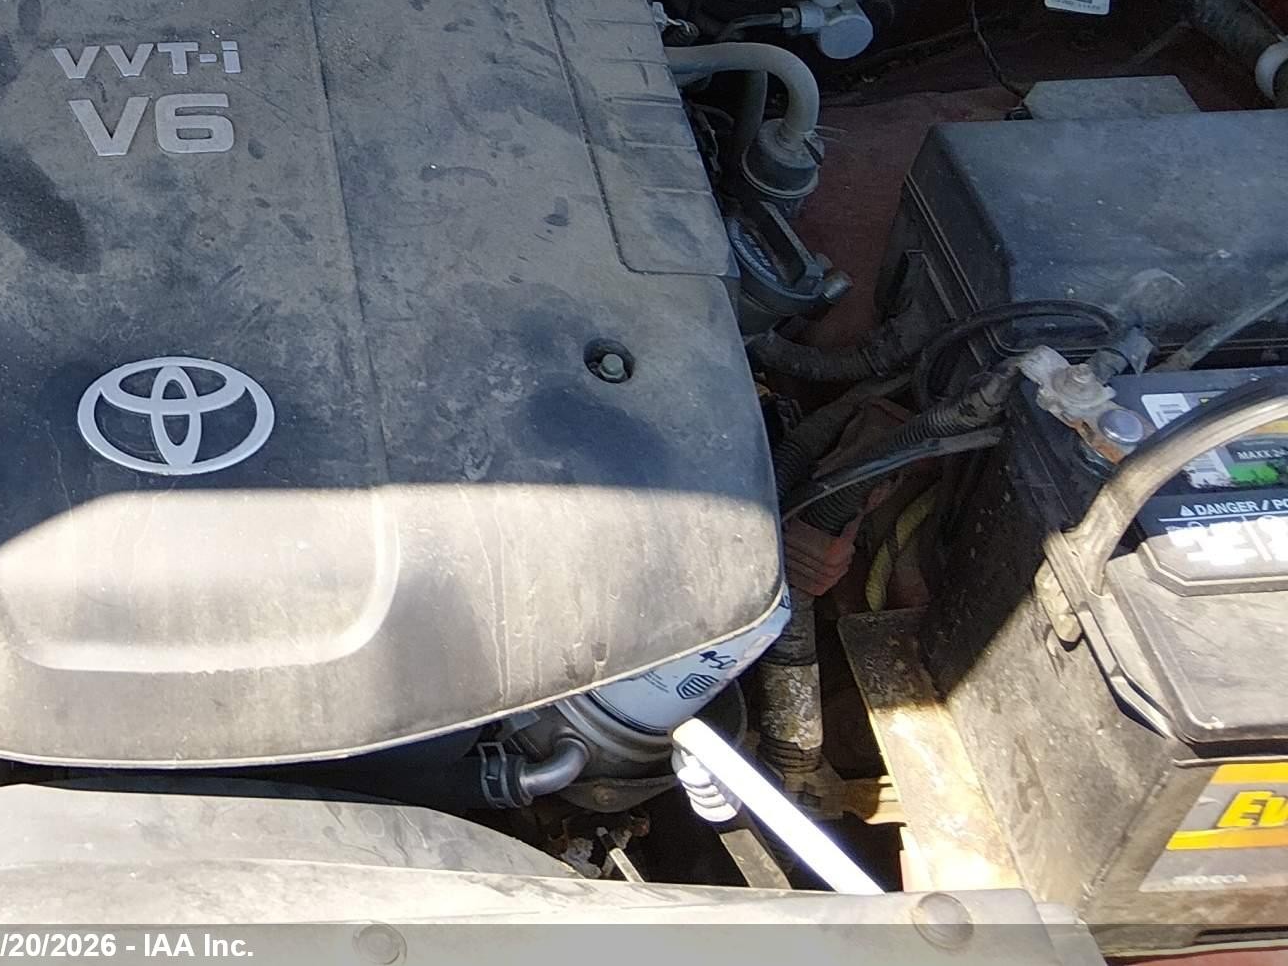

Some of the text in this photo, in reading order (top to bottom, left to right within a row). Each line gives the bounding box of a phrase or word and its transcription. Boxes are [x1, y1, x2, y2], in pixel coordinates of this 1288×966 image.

[52, 41, 242, 80] VVT-i
[69, 93, 235, 157] V6
[1236, 449, 1272, 460] MAXX
[1193, 501, 1260, 516] DANGER
